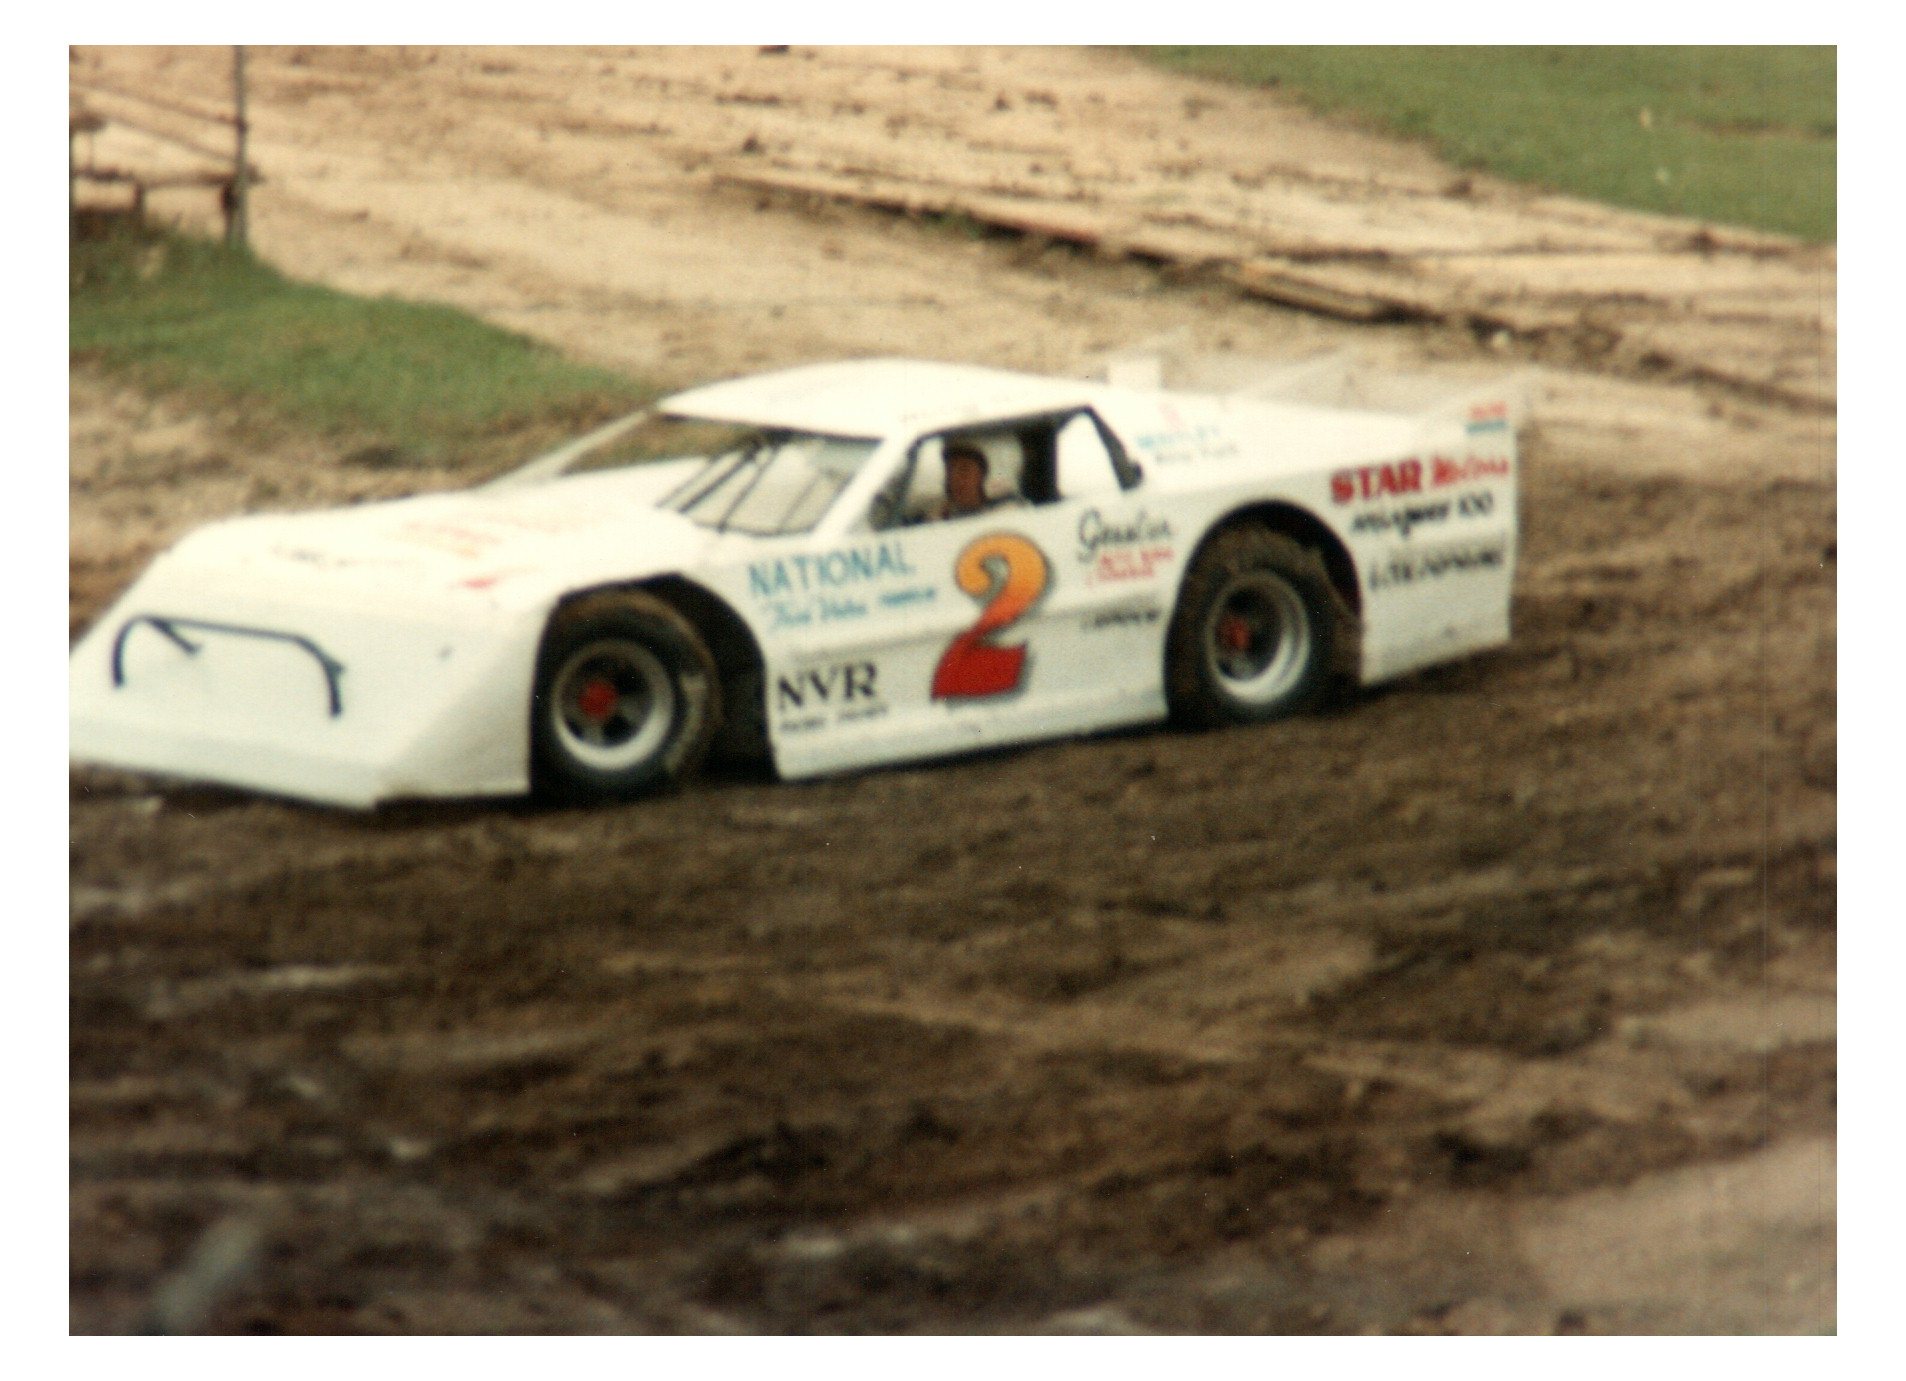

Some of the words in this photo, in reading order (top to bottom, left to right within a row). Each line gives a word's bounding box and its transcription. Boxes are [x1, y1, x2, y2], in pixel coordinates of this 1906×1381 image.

[1331, 456, 1422, 506] STAR
[748, 542, 915, 597] NATIONAL
[930, 530, 1056, 709] 2
[777, 661, 878, 714] NVR
